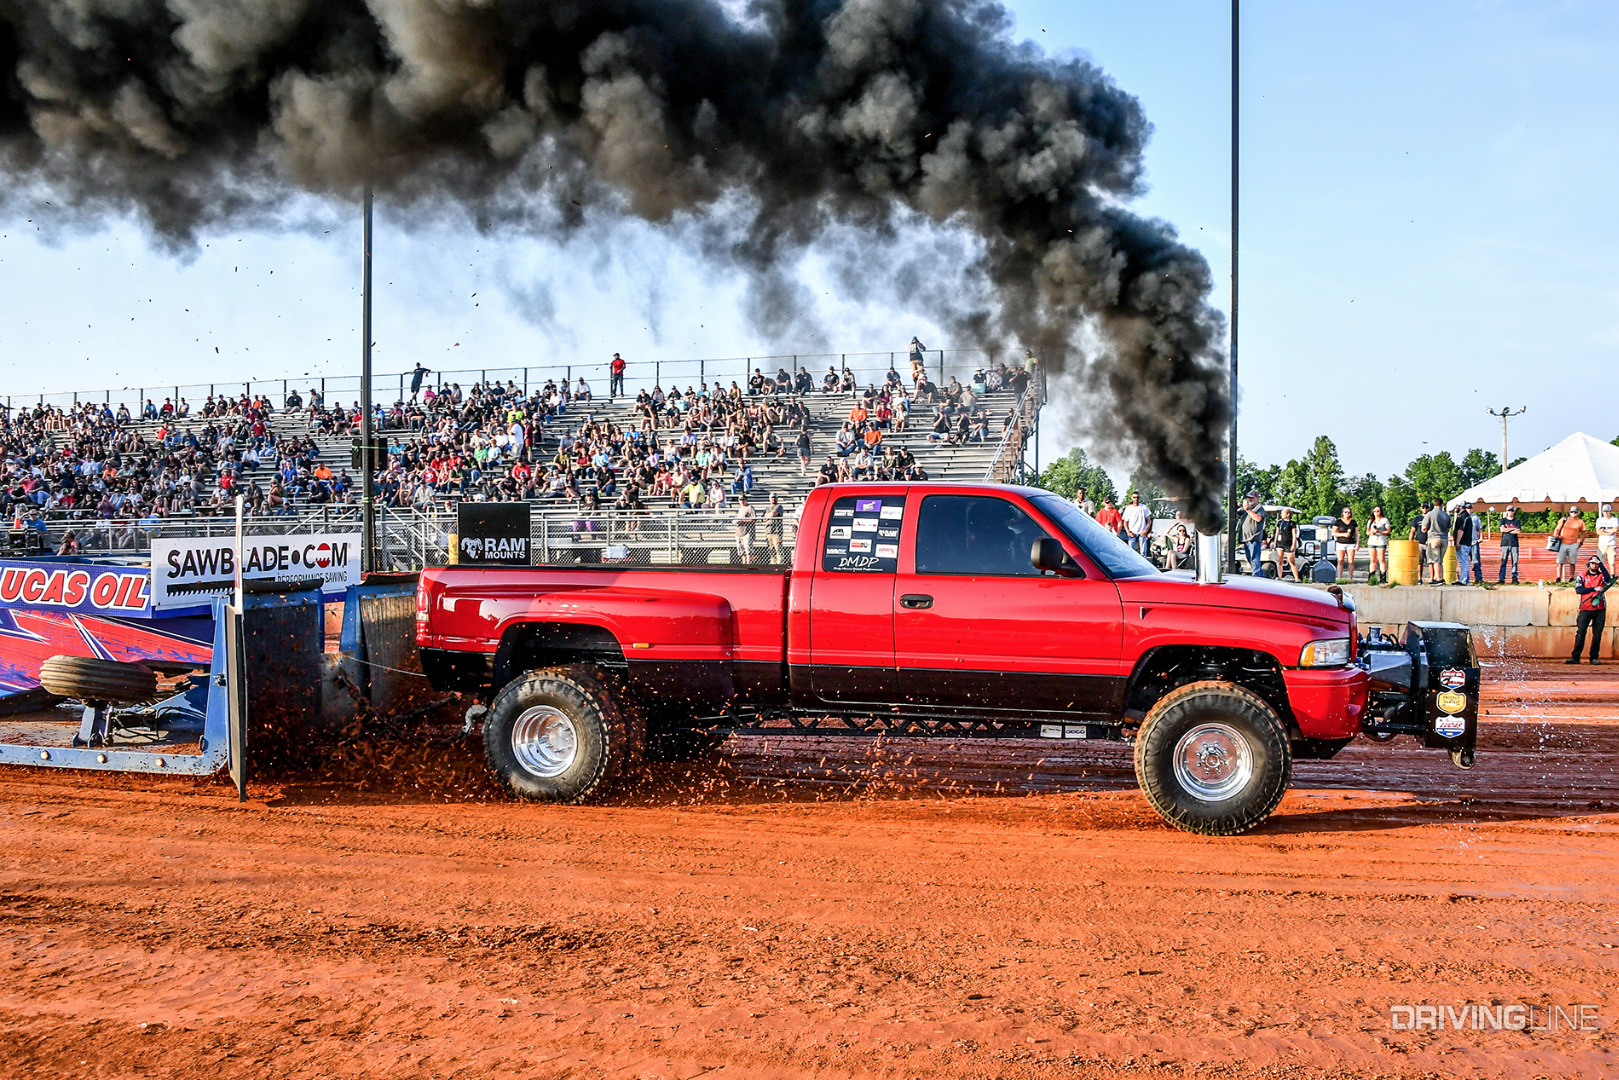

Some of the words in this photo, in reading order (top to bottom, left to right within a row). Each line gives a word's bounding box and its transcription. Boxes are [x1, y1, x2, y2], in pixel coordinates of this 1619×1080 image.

[484, 537, 526, 551] RAM
[484, 551, 526, 559] MOUNTS
[838, 555, 880, 567] DMDP
[325, 571, 348, 583] SAWING
[0, 568, 90, 607] UCAS
[91, 573, 149, 610] OIL
